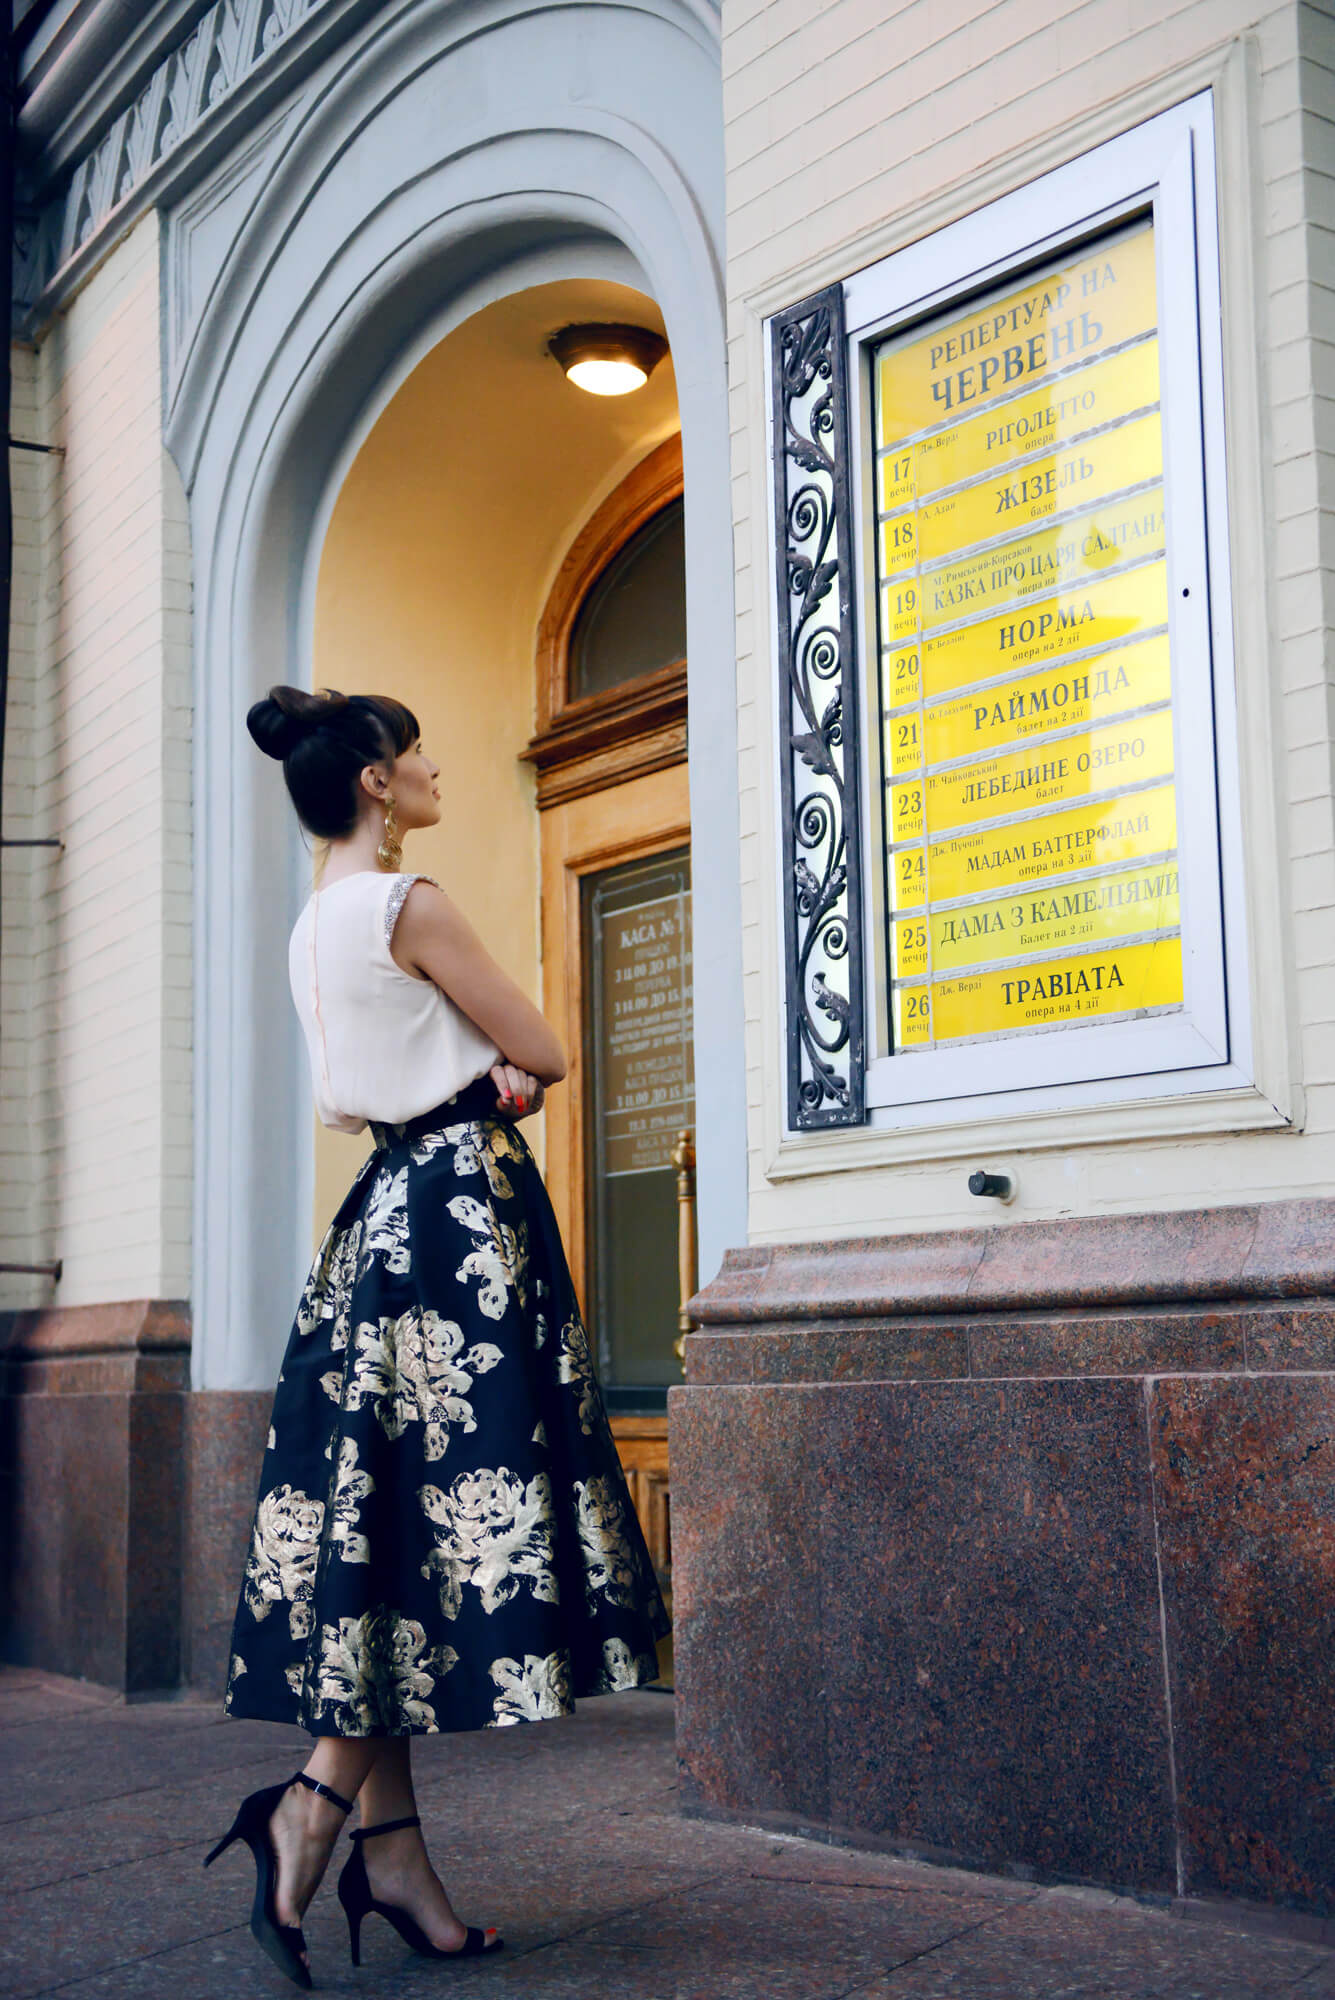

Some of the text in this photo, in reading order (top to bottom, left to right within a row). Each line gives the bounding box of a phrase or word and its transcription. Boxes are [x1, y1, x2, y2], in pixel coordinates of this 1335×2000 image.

[930, 263, 1117, 370] РЕПЕРТУАР НА
[930, 310, 1104, 411] ЧЕРВЕНЬ
[986, 390, 1096, 450] РІГОЛЕТТО
[893, 457, 911, 482] 17
[995, 457, 1094, 514] ЖІЗЕЛЬ
[893, 522, 913, 548] 18
[935, 577, 986, 611] КАЗКА
[991, 561, 1026, 591] ПРО
[1031, 542, 1076, 577] ЦАРЯ
[896, 589, 916, 615] 19
[999, 599, 1096, 650] НОРМА
[1012, 648, 1040, 662] опера
[1057, 637, 1064, 647] 2
[896, 654, 919, 680] 20
[974, 665, 1131, 731] РАЙМОНДА
[898, 722, 918, 747] 21
[1016, 719, 1043, 735] балет
[1061, 711, 1067, 722] 2
[962, 737, 1146, 804] ЛЕБЕДИНЕ ОЗЕРО
[898, 791, 922, 816] 23
[1036, 784, 1065, 800] балет
[902, 855, 926, 880] 24
[967, 844, 1027, 873] МАДАМ
[1018, 862, 1049, 877] опера
[1052, 860, 1064, 869] на
[1068, 853, 1075, 865] 3
[940, 871, 1179, 947] ДАМА З КАМЕЛІЯМИ
[620, 923, 657, 949] КАСА
[903, 926, 926, 949] 25
[1020, 931, 1051, 945] Балет
[1054, 928, 1067, 938] на
[1070, 925, 1076, 935] 2
[1001, 963, 1125, 1006] ТРАВІАТА
[906, 994, 930, 1018] 26
[1025, 996, 1100, 1019] опера на 4 дії
